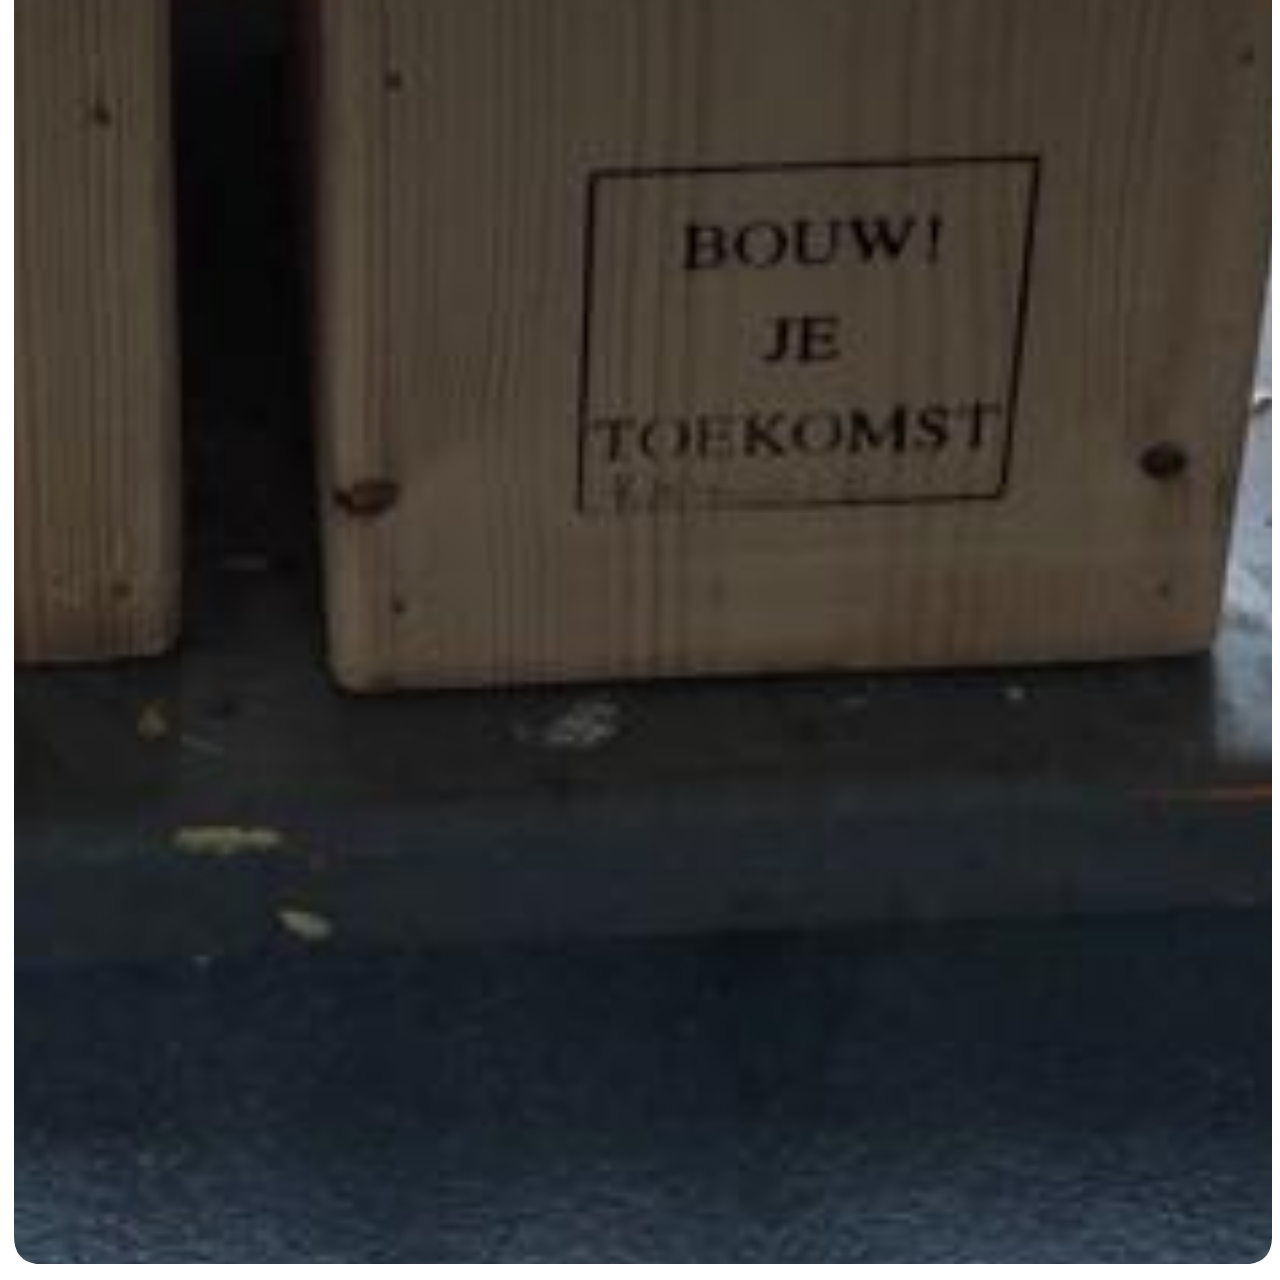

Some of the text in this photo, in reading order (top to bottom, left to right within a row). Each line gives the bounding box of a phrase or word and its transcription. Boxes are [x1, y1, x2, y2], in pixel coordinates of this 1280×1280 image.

[684, 215, 943, 271] BOUW!
[762, 317, 840, 363] JE
[594, 402, 1001, 462] TOEKOMST
